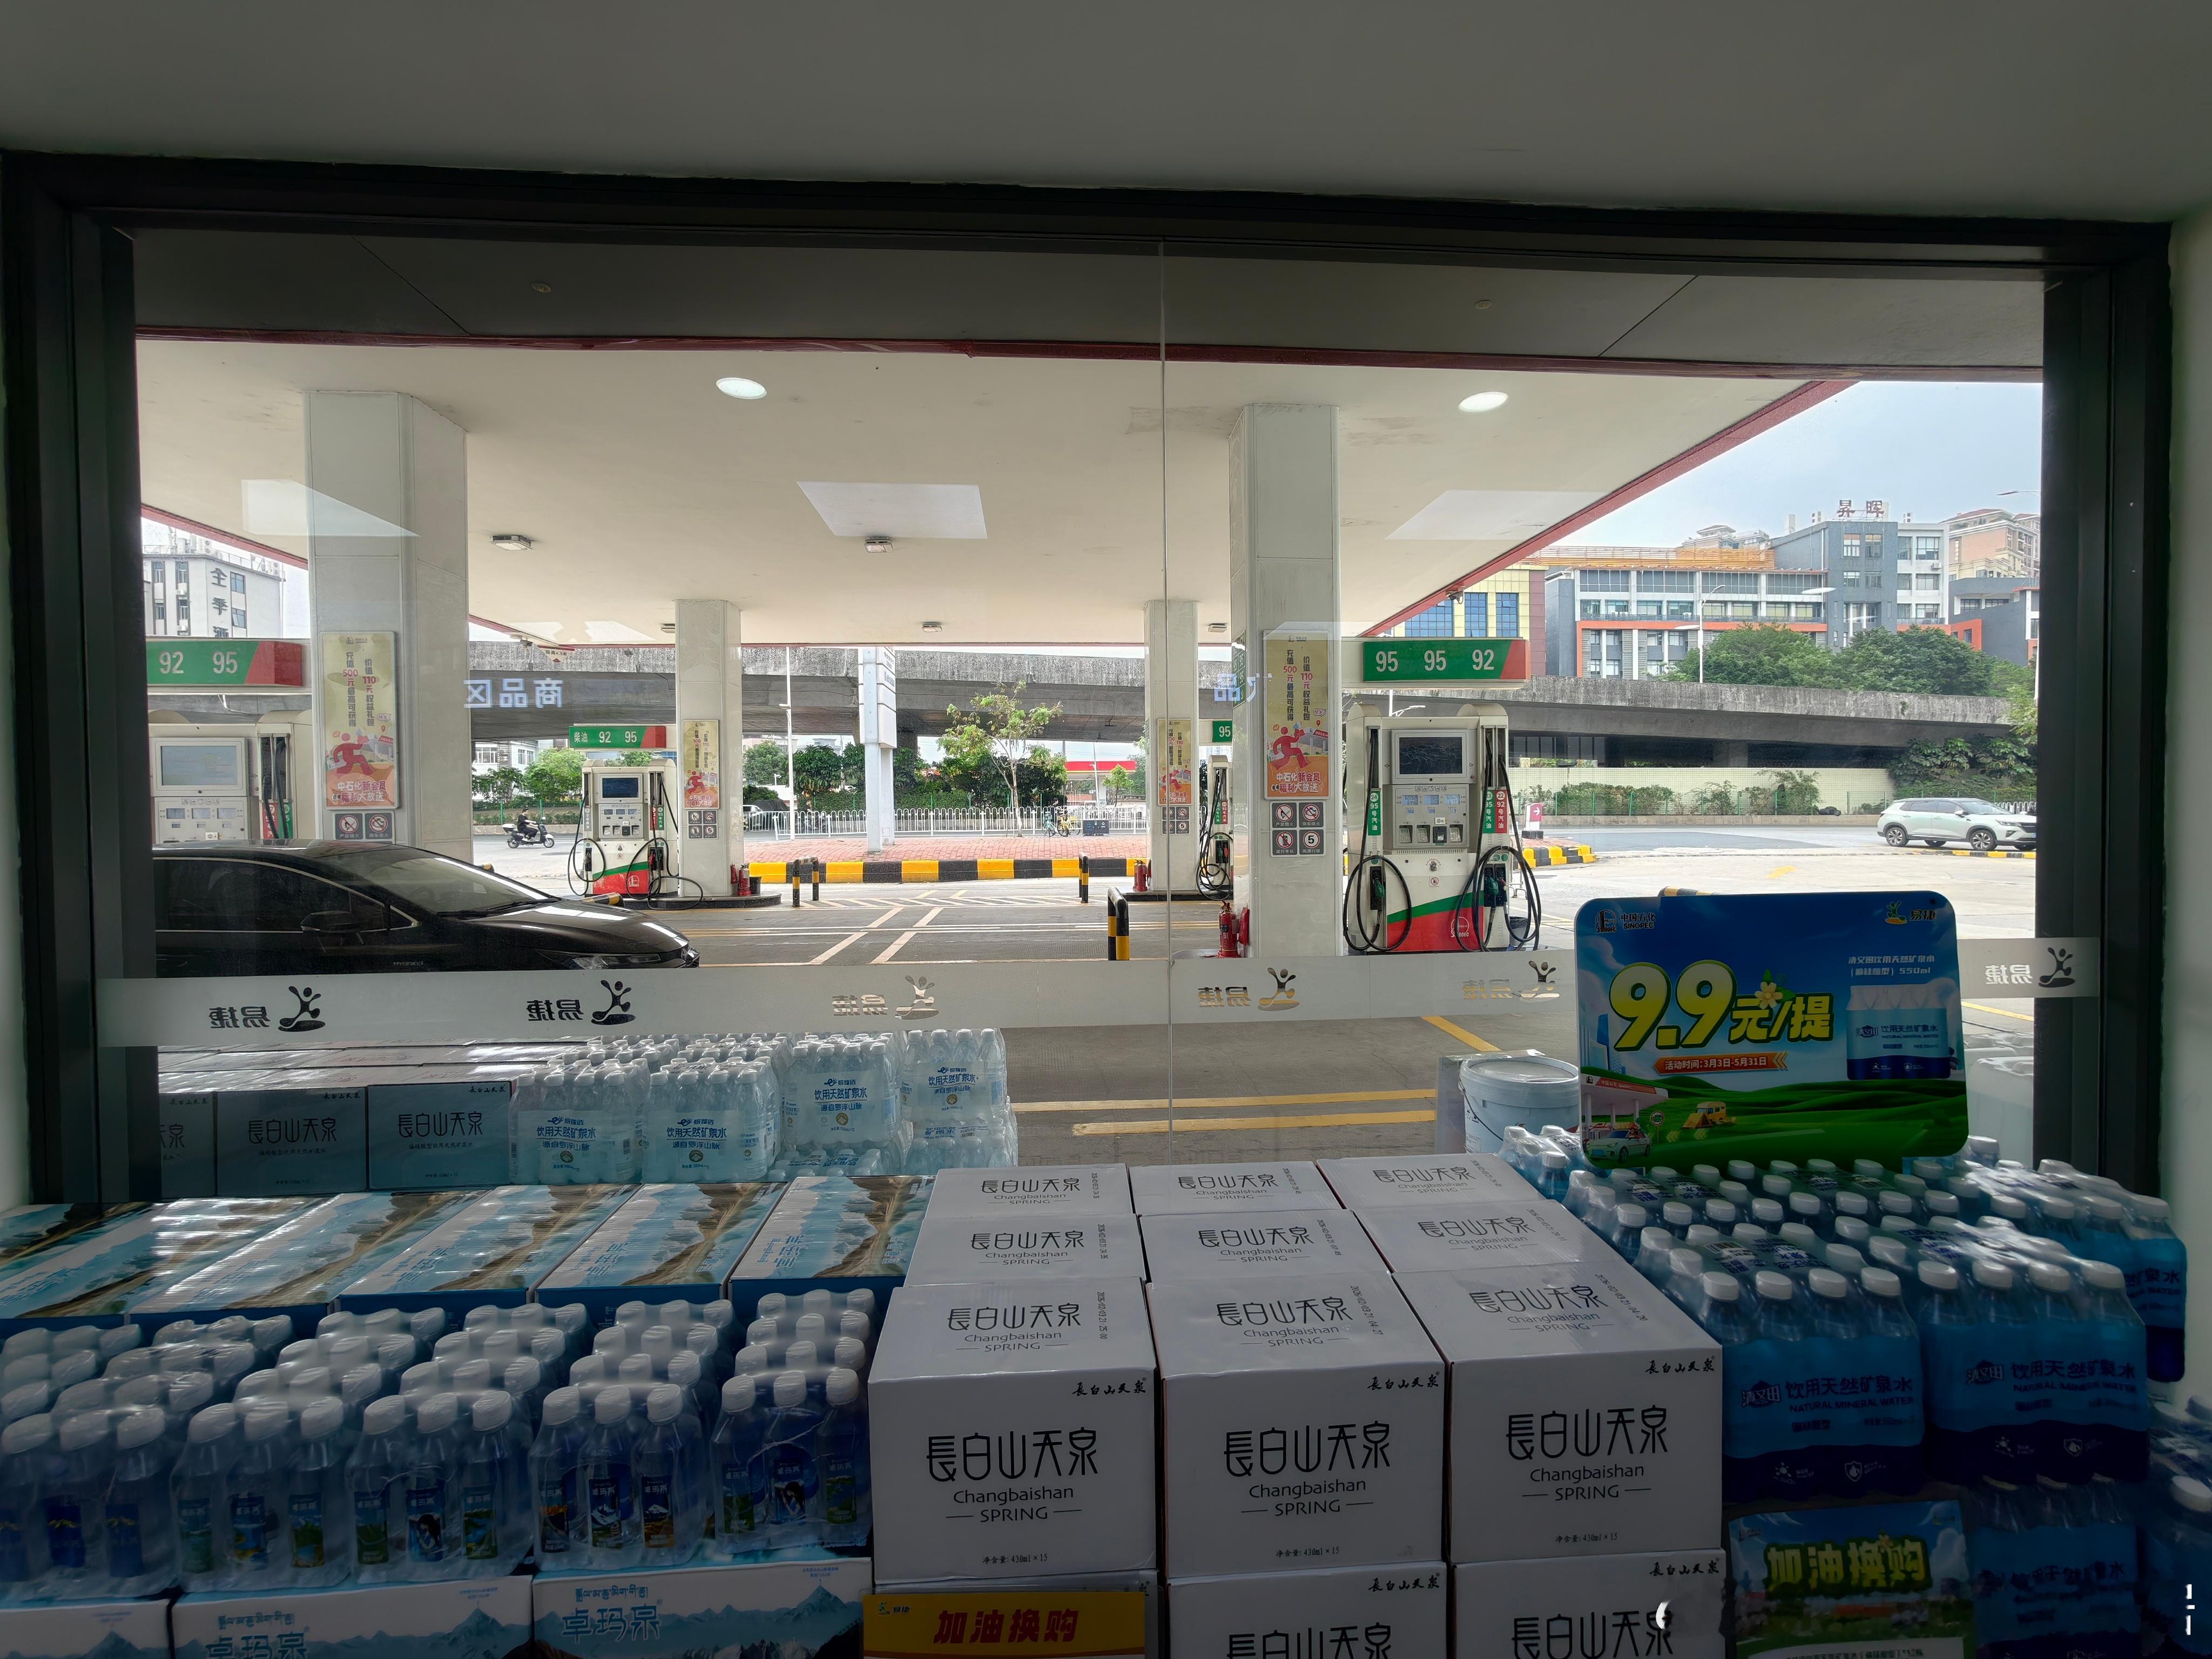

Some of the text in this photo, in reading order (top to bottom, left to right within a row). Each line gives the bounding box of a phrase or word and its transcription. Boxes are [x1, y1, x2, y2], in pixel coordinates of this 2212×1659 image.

[159, 651, 238, 674] 92 95
[1375, 649, 1494, 672] 95 95 92
[574, 731, 637, 743] 柴油 92 95
[1219, 726, 1231, 737] 95
[1370, 802, 1379, 831] 95号汽油
[1496, 801, 1505, 828] 92号汽油
[1308, 835, 1315, 844] 5
[1621, 912, 1655, 921] 中国石化
[1910, 909, 1936, 920] 易捷
[928, 1073, 976, 1085] 饮用天然矿泉水
[814, 1087, 868, 1100] 饮用天然矿泉水
[820, 1103, 863, 1112] 源自罗浮山脉
[247, 1117, 338, 1144] 長白山天泉
[397, 1111, 483, 1138] 長白山天泉
[536, 1126, 596, 1139] 饮用天然矿泉水
[666, 1127, 727, 1138] 饮用天然矿泉水
[542, 1141, 590, 1151] 源自罗浮山脉
[672, 1141, 720, 1150] 源自罗浮山脉
[1178, 1174, 1279, 1189] 長白山天泉
[1373, 1166, 1476, 1183] 長白山天泉
[981, 1177, 1081, 1193] 長白山天泉
[1397, 1182, 1468, 1190] Changbaishan
[1417, 1216, 1537, 1238] 長白山天泉
[970, 1230, 1085, 1250] 長白山天泉
[1198, 1226, 1314, 1247] 長白山天泉
[1448, 1236, 1528, 1245] Changbaishan
[985, 1251, 1068, 1259] Changbaishan
[1220, 1247, 1302, 1256] Changbaishan
[1472, 1243, 1519, 1251] SPRING
[1468, 1285, 1609, 1313] 長白山天泉
[947, 1303, 1082, 1331] 長白山天泉
[1217, 1296, 1354, 1326] 長白山天泉
[1507, 1312, 1601, 1324] Changbaishan
[1244, 1326, 1339, 1338] Changbaishan
[1534, 1323, 1590, 1333] SPRING
[965, 1331, 1062, 1343] Changbaishan
[1268, 1337, 1324, 1347] SPRING
[984, 1343, 1041, 1352] SPRING
[2011, 1359, 2135, 1379] 饮用天然矿泉水
[1785, 1375, 1912, 1399] 饮用天然矿泉水
[1789, 1397, 1914, 1413] NATURAL MINERAL WATER
[1506, 1405, 1668, 1461] 長白山天泉
[926, 1427, 1098, 1482] 長白山天泉
[1224, 1420, 1391, 1478] 長白山天泉
[1530, 1464, 1644, 1484] Changbaishan
[953, 1486, 1074, 1506] Changbaishan
[1249, 1479, 1366, 1499] Changbaishan
[1555, 1485, 1620, 1501] SPRING
[981, 1506, 1048, 1523] SPRING
[1274, 1500, 1340, 1516] SPRING
[1767, 1539, 1926, 1592] 加油换购
[562, 1604, 660, 1644] 卓玛泉
[933, 1608, 1080, 1644] 加油换购
